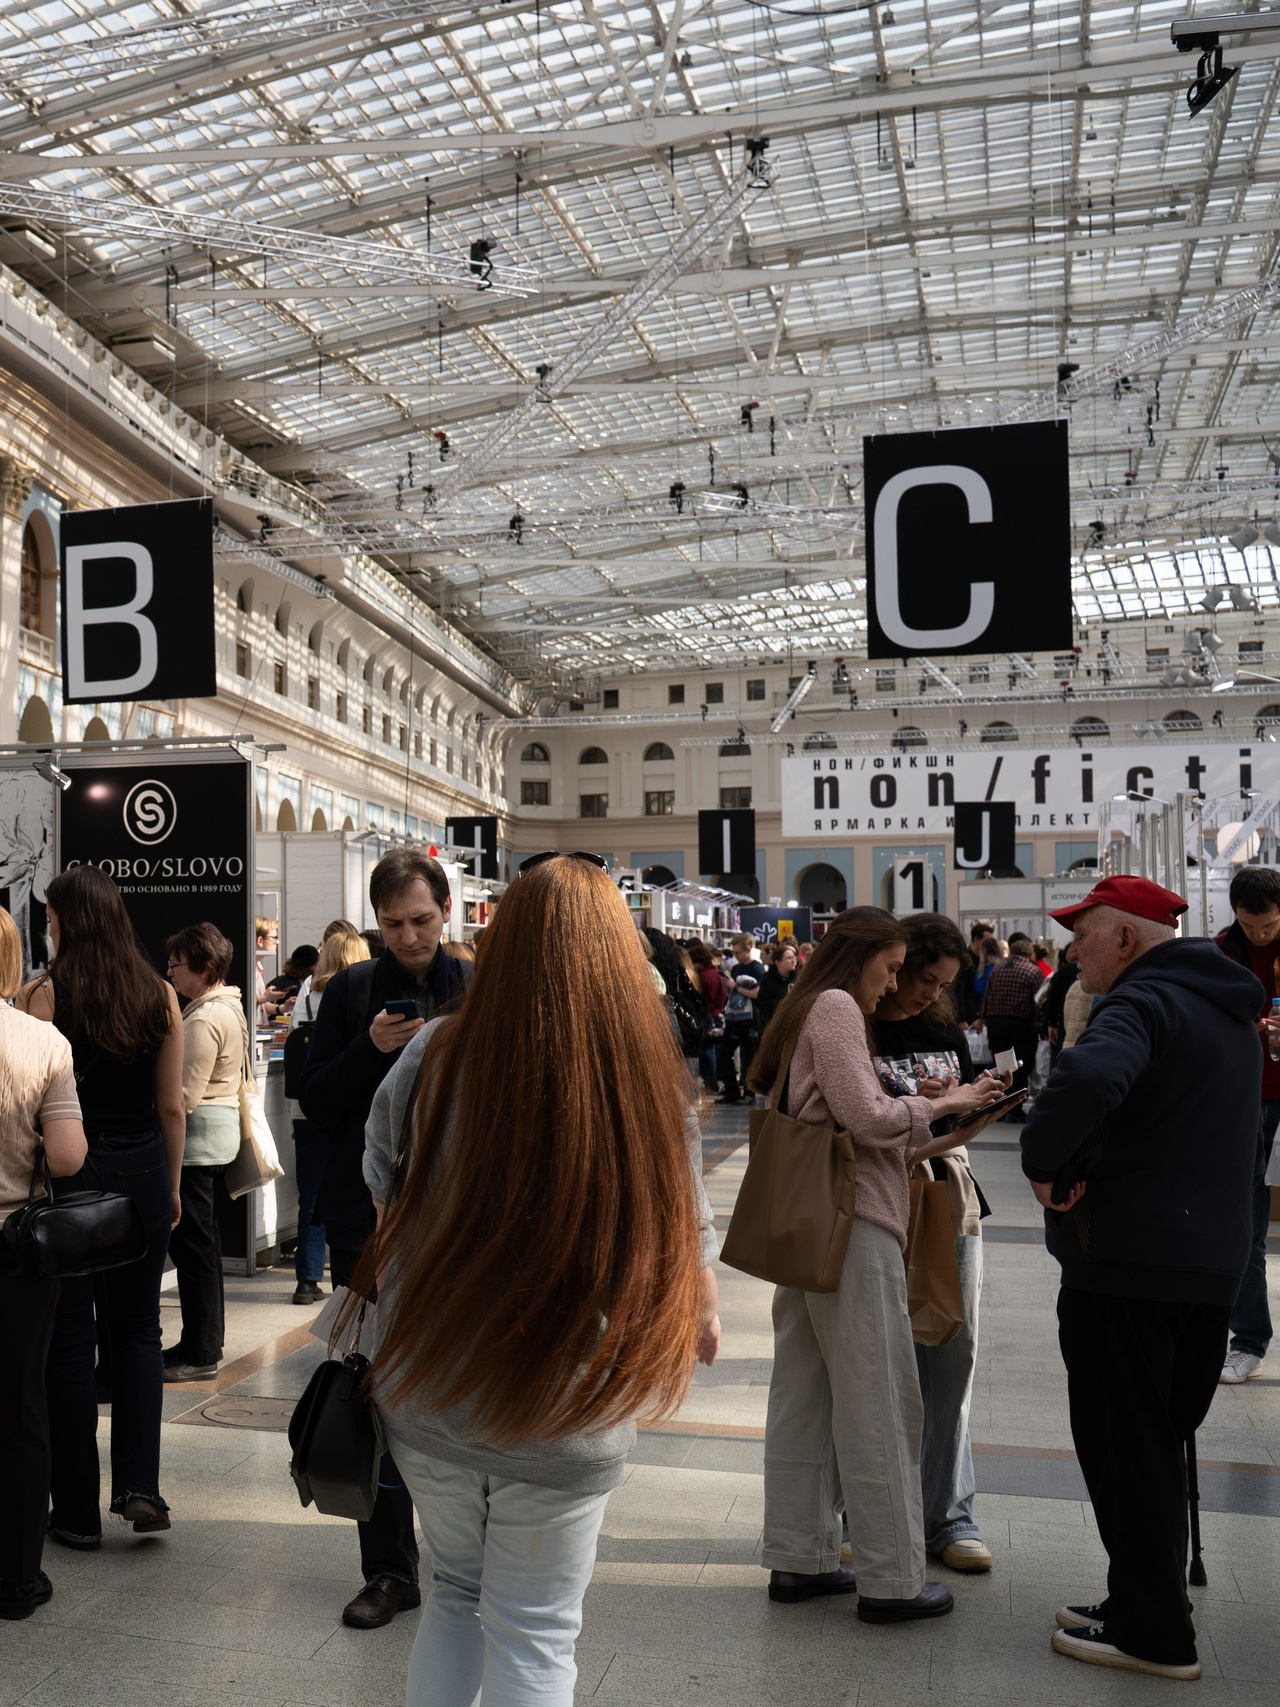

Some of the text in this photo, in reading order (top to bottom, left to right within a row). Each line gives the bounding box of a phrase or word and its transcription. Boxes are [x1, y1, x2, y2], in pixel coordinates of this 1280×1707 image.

[874, 465, 994, 649] C
[66, 541, 158, 698] B
[814, 756, 954, 771] НОН/ФИКШН
[1253, 800, 1272, 823] КОСМОС
[815, 817, 925, 830] ЯРМАРКА
[956, 811, 990, 868] J
[1224, 837, 1243, 860] КОСМОС
[219, 884, 243, 892] ГОДУ
[899, 862, 924, 909] 1
